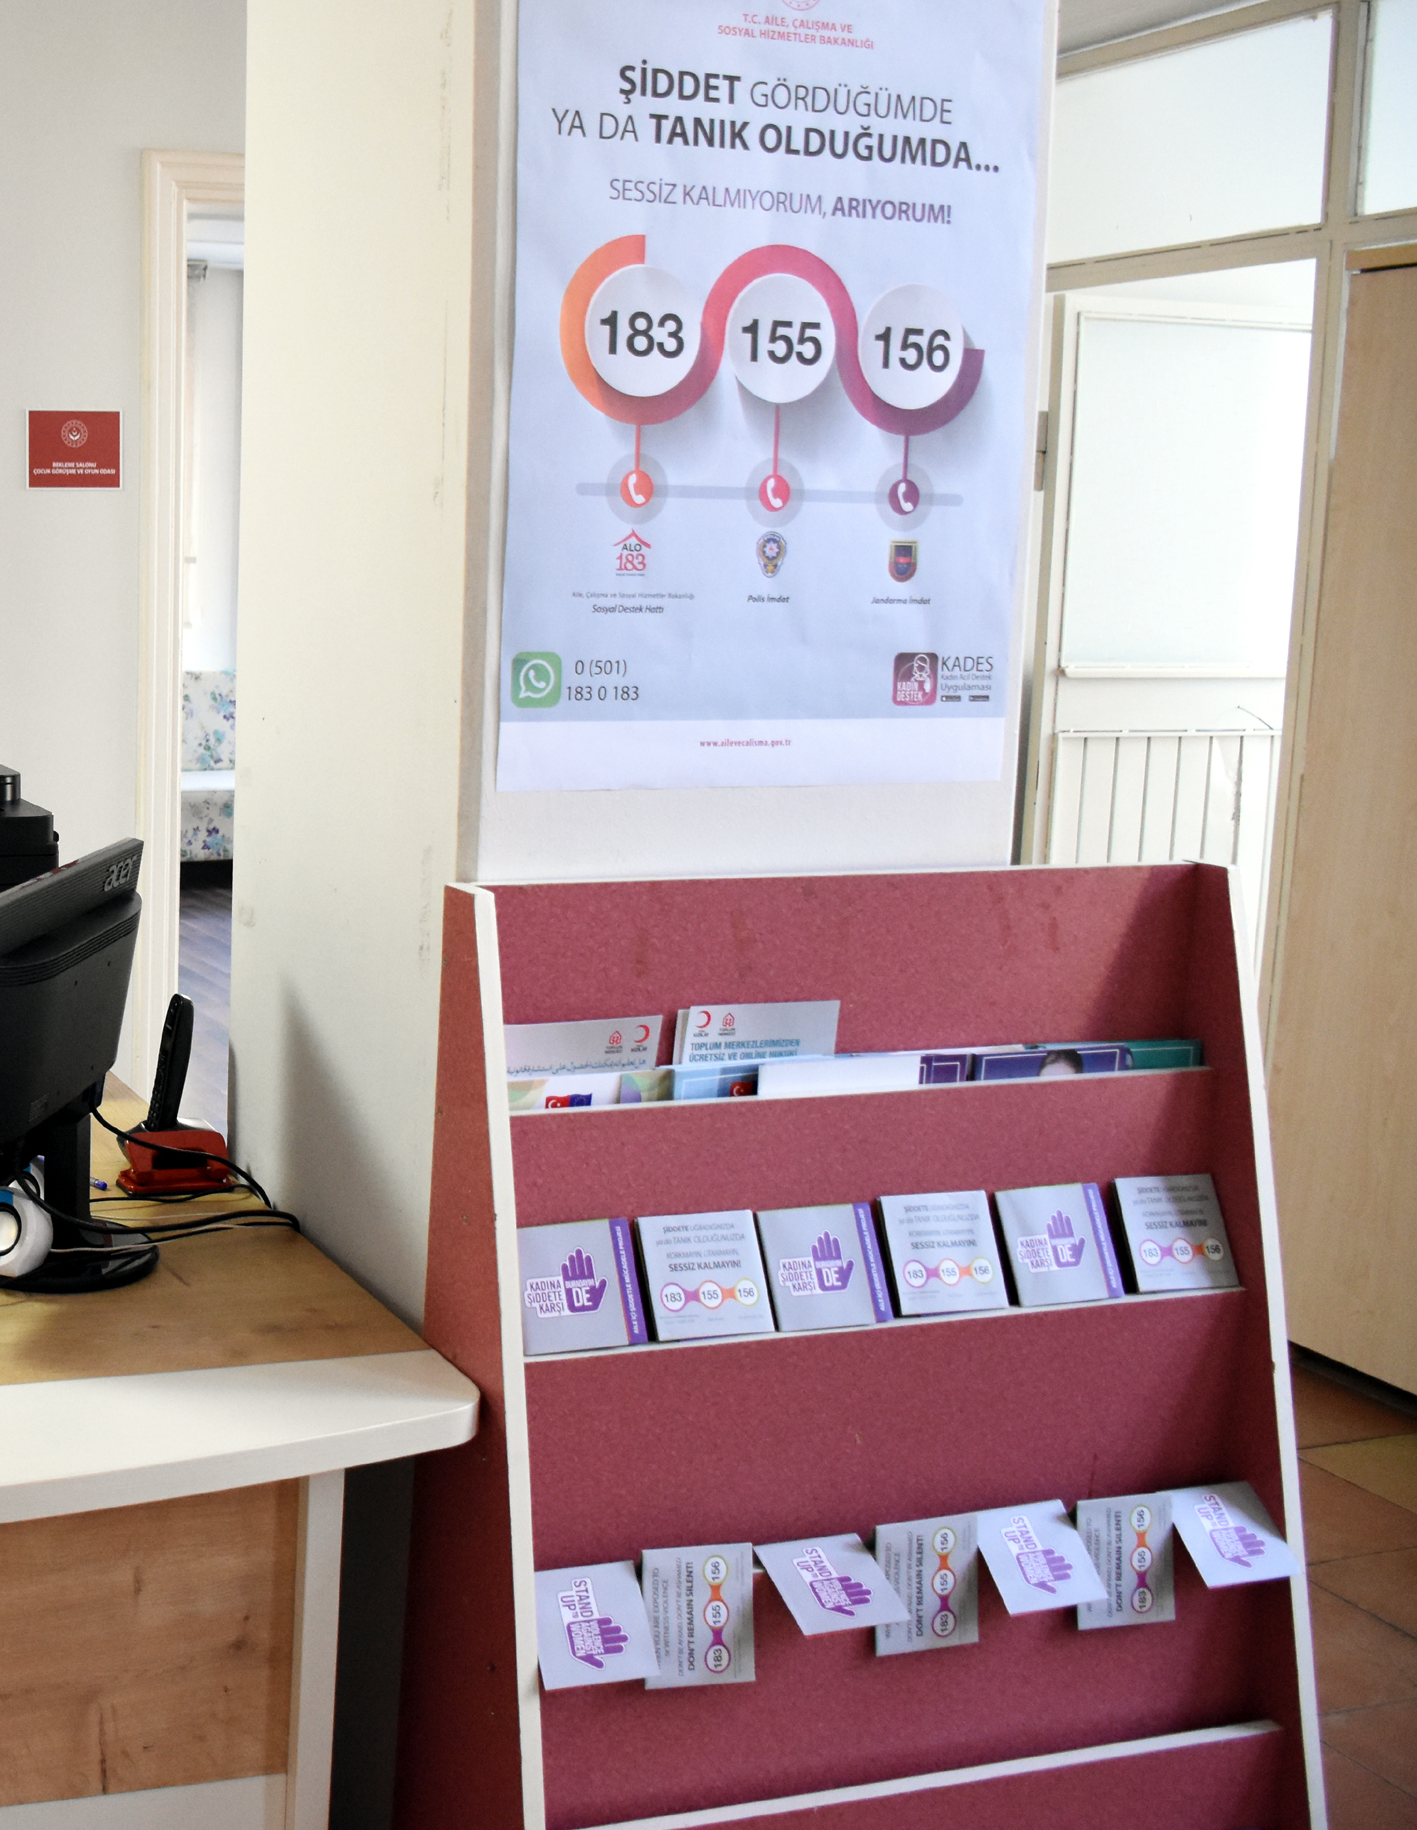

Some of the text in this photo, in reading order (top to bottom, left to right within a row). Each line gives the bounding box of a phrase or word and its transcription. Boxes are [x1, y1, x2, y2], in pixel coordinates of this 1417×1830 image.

[743, 14, 853, 33] T.C. AİLE, ÇALIŞMA VE
[718, 25, 874, 49] SOSYAL HİZMETLER BAKANLIĞI
[618, 60, 953, 125] ŞİDDET GÖRDÜĞÜMDE
[551, 108, 1000, 173] YA DA TANIK OLDUĞUMDA...
[609, 176, 952, 225] SESSİZ KALMIYORUM, ARIYORUM!
[599, 310, 685, 359] 183
[741, 319, 822, 367] 155
[874, 326, 951, 374] 156
[622, 543, 642, 552] ALO
[616, 553, 646, 571] 183
[747, 594, 790, 603] Polis İmdat
[871, 596, 931, 605] Jandarma İmdat
[592, 604, 664, 615] Sosyal Destek Hattı
[574, 659, 627, 678] 0 (501)
[941, 656, 993, 672] KADES
[565, 685, 639, 701] 183 0 183
[940, 683, 992, 692] Uygulaması
[897, 691, 922, 701] DESTEK
[104, 854, 138, 892] acer
[691, 1042, 722, 1051] TOPLUM
[689, 1052, 726, 1062] ÜCRETSİZ
[728, 1052, 737, 1060] VE
[1145, 1221, 1168, 1230] SESSİZ
[911, 1239, 936, 1250] SESSİZ
[1020, 1238, 1048, 1248] KADINA
[1057, 1245, 1075, 1263] DE
[1143, 1245, 1221, 1258] 183 155 156
[669, 1260, 742, 1272] SESSİZ KALMAYIN!
[781, 1259, 813, 1271] KADINA
[907, 1266, 990, 1279] 183 155 156
[780, 1271, 814, 1285] ŞİDDETE
[823, 1267, 841, 1286] DE
[529, 1279, 561, 1291] KADINA
[792, 1281, 816, 1295] KARŞI
[526, 1291, 563, 1306] ŞİDDETE
[572, 1287, 593, 1307] DE
[664, 1288, 754, 1302] 183 155 156
[539, 1302, 564, 1316] KARŞI
[1197, 1507, 1213, 1521] UP
[1204, 1495, 1229, 1527] STAND
[1003, 1530, 1020, 1544] UP
[1012, 1517, 1038, 1550] STAND
[796, 1560, 814, 1573] UP
[806, 1548, 832, 1578] STAND
[1115, 1547, 1123, 1581] REMAIN
[1137, 1510, 1146, 1609] 183 155 156
[940, 1532, 949, 1632] 183 155 156
[560, 1594, 576, 1611] UP
[574, 1579, 594, 1618] STAND
[686, 1599, 694, 1638] REMAIN
[711, 1561, 722, 1668] 183 155 156
[570, 1623, 587, 1656] WOMEN
[687, 1639, 695, 1671] DON'T
